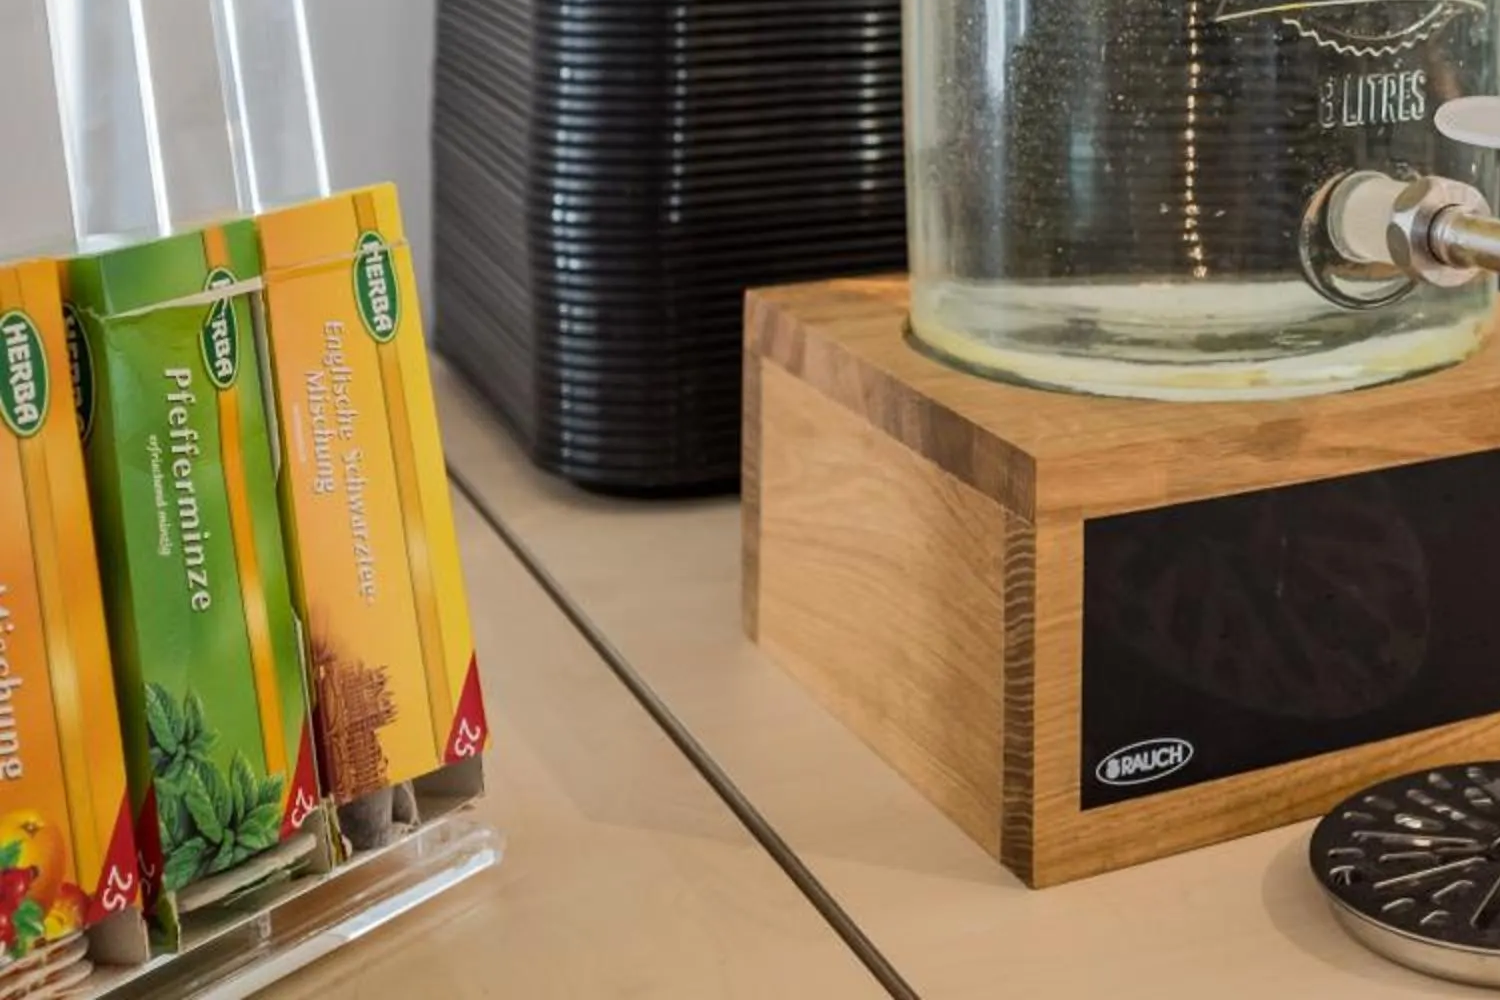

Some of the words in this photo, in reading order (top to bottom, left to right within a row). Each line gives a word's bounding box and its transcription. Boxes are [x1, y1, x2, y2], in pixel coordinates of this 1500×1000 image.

[1342, 68, 1427, 127] LITRES
[209, 277, 234, 378] RBA
[362, 241, 393, 332] HERBA
[2, 321, 39, 425] HERBA
[321, 320, 358, 440] Englische
[304, 370, 338, 494] Mischung
[164, 368, 212, 612] Pfefferminze
[454, 717, 481, 757] 25
[1121, 744, 1183, 777] RAUCH
[102, 864, 134, 912] 25
